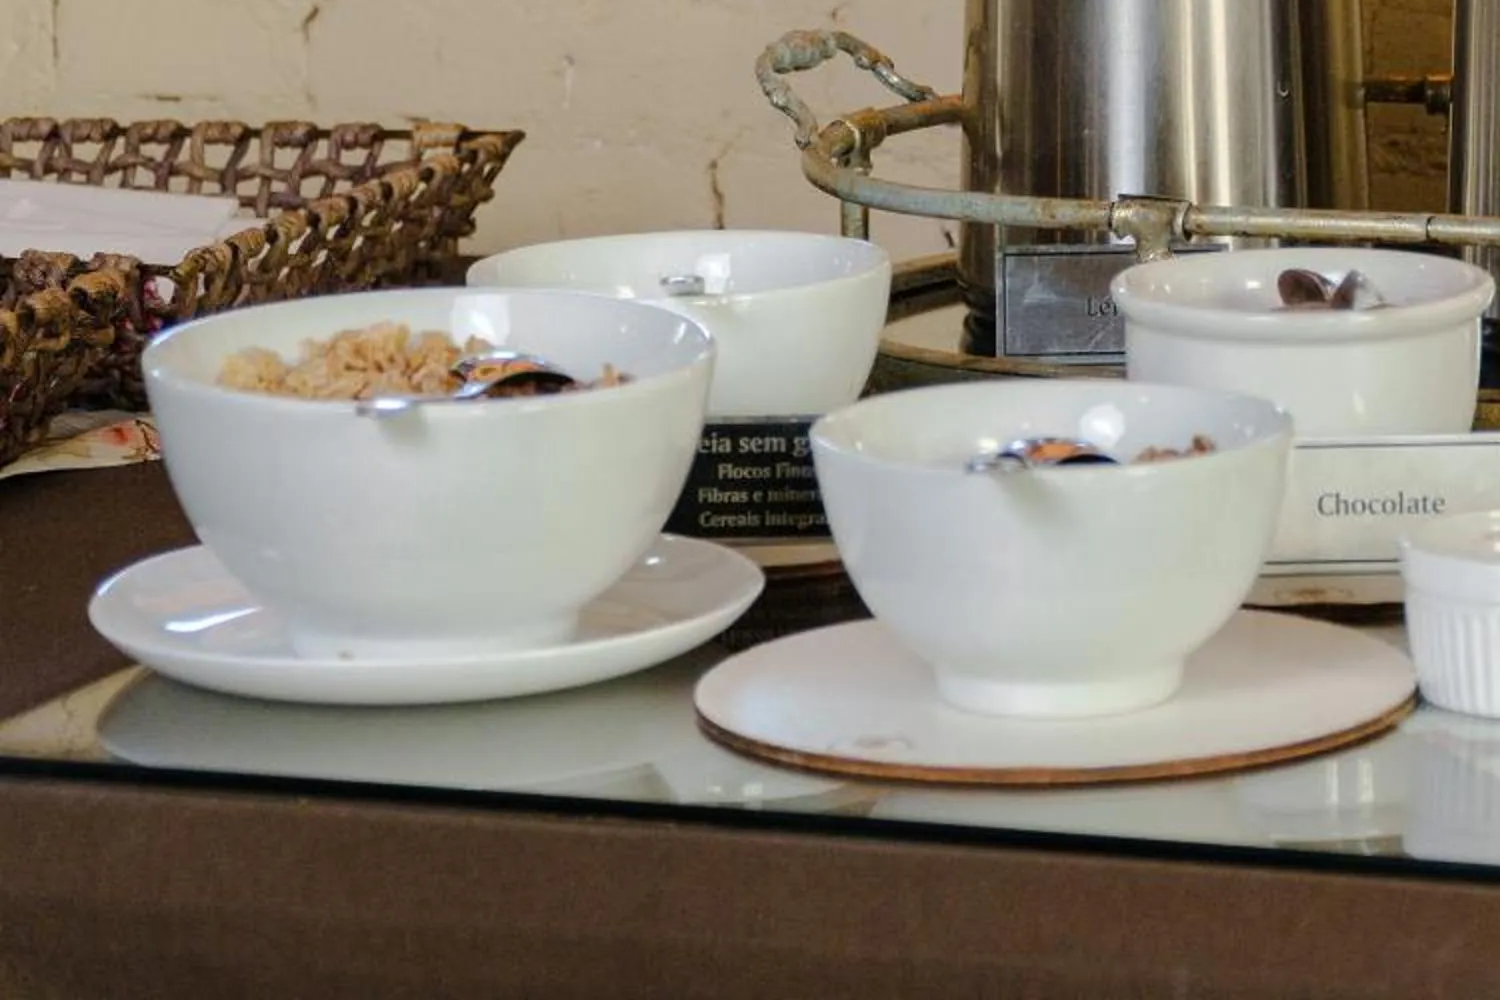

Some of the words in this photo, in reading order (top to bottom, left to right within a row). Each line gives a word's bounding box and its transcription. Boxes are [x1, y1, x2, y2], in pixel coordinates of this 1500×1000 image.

[1087, 296, 1118, 317] Lei
[698, 431, 732, 454] eia
[739, 435, 787, 454] sem
[717, 463, 771, 480] Flocos
[775, 461, 816, 479] Fino
[698, 488, 749, 504] Fibras
[1316, 491, 1446, 516] Chocolate
